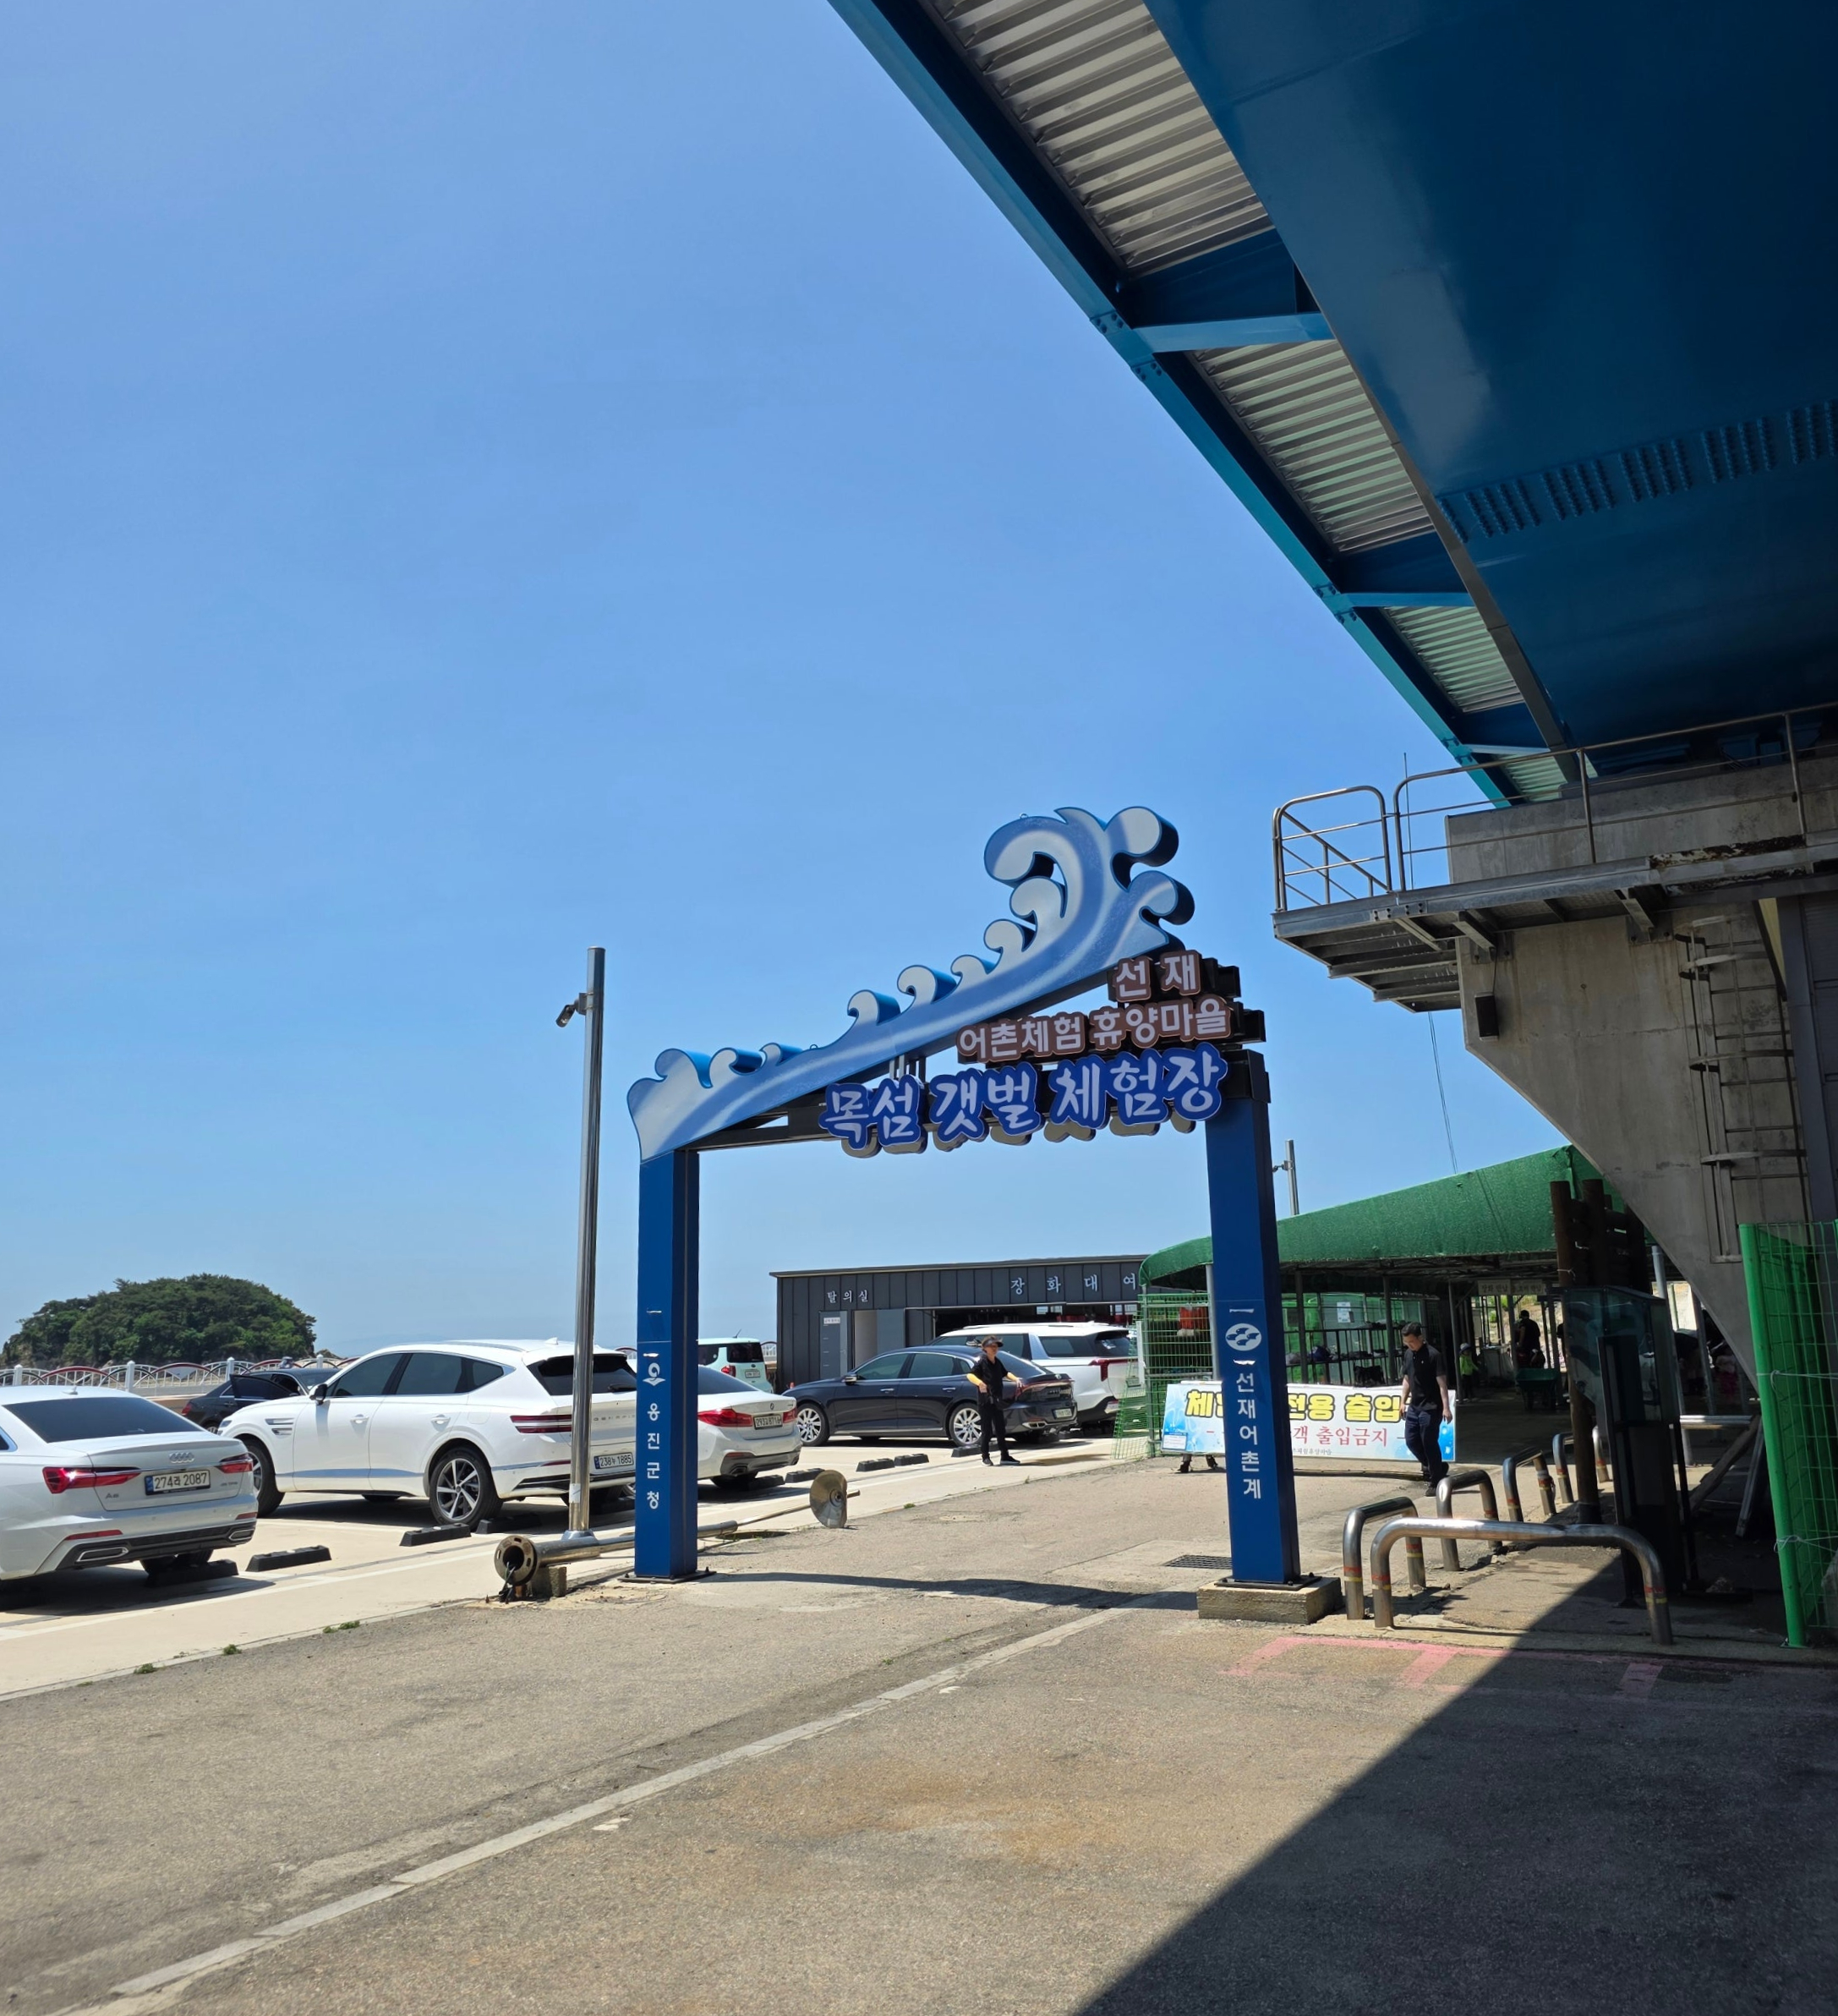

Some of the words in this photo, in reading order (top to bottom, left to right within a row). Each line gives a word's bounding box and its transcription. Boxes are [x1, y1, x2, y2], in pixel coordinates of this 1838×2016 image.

[1116, 954, 1196, 997] 선재
[960, 1016, 1081, 1058] 어촌체험
[1094, 999, 1227, 1046] 휴양마을
[824, 1082, 914, 1143] 목섬
[935, 1070, 1034, 1137] 갯벌
[1056, 1050, 1220, 1122] 체험장
[827, 1290, 868, 1303] 탈의실
[1010, 1273, 1136, 1295] 장화대여
[1343, 1394, 1411, 1422] 출입
[1236, 1372, 1261, 1499] 선재어촌계
[1316, 1427, 1387, 1447] 출입금지
[647, 1402, 660, 1509] 옹진군청
[154, 1476, 181, 1489] 274라
[183, 1472, 207, 1486] 2087
